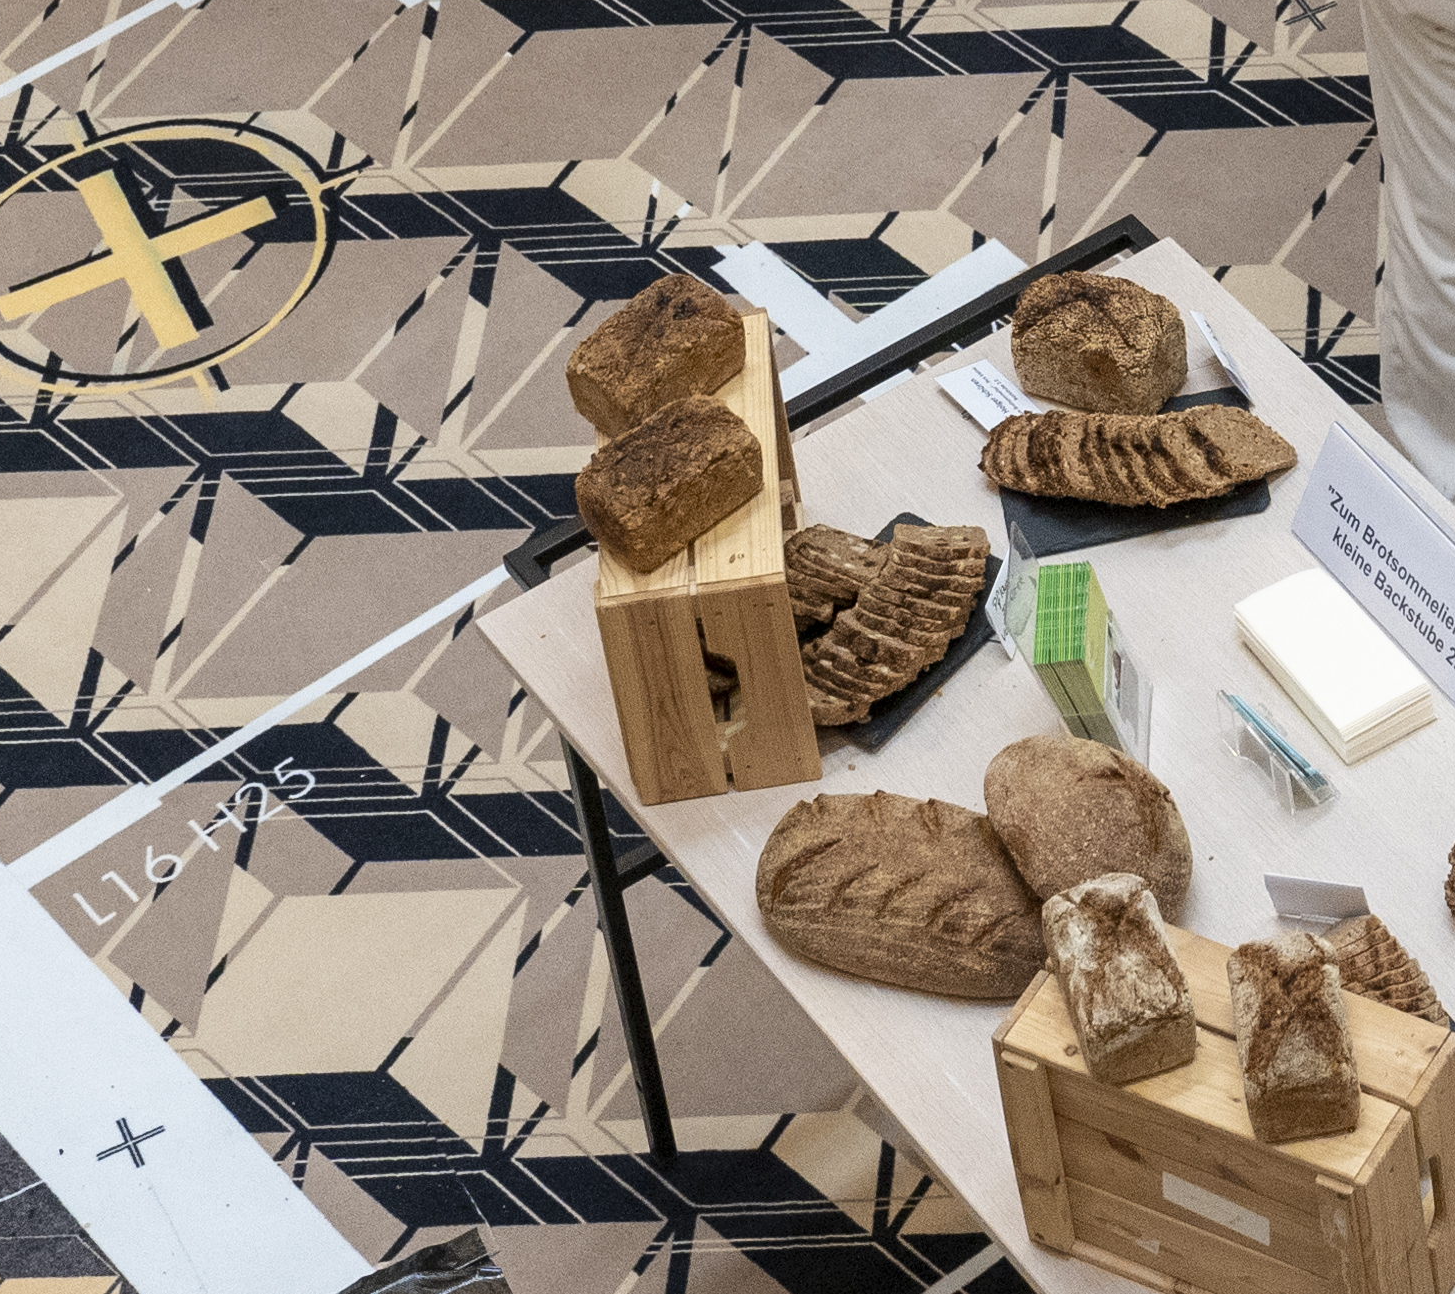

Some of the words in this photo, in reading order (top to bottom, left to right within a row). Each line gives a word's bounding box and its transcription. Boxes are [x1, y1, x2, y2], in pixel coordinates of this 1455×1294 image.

[1326, 483, 1361, 533] "Zum
[1331, 524, 1373, 578] kleine
[1372, 568, 1445, 653] Backstube
[71, 843, 188, 928] L16
[174, 757, 317, 850] H25
